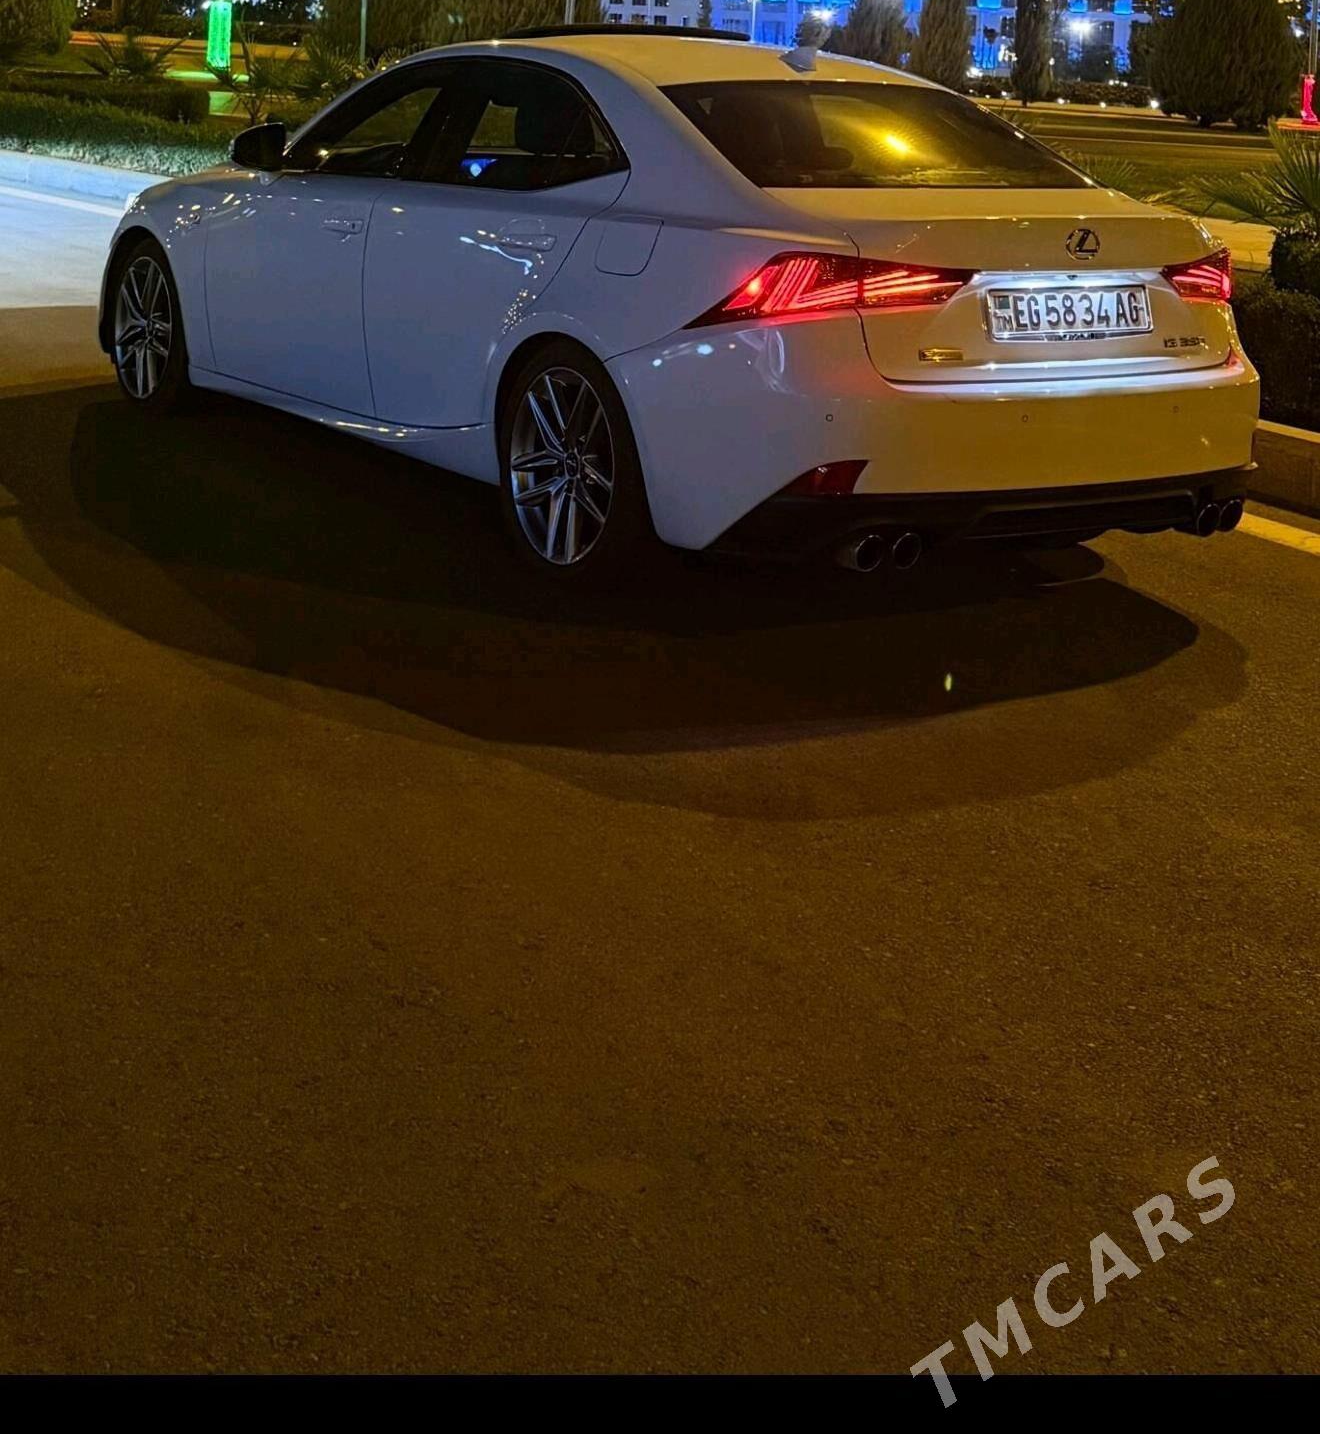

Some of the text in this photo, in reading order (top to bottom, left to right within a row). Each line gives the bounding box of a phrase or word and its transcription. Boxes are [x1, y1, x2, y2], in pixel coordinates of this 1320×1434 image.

[1012, 292, 1140, 328] EG 5834 AG
